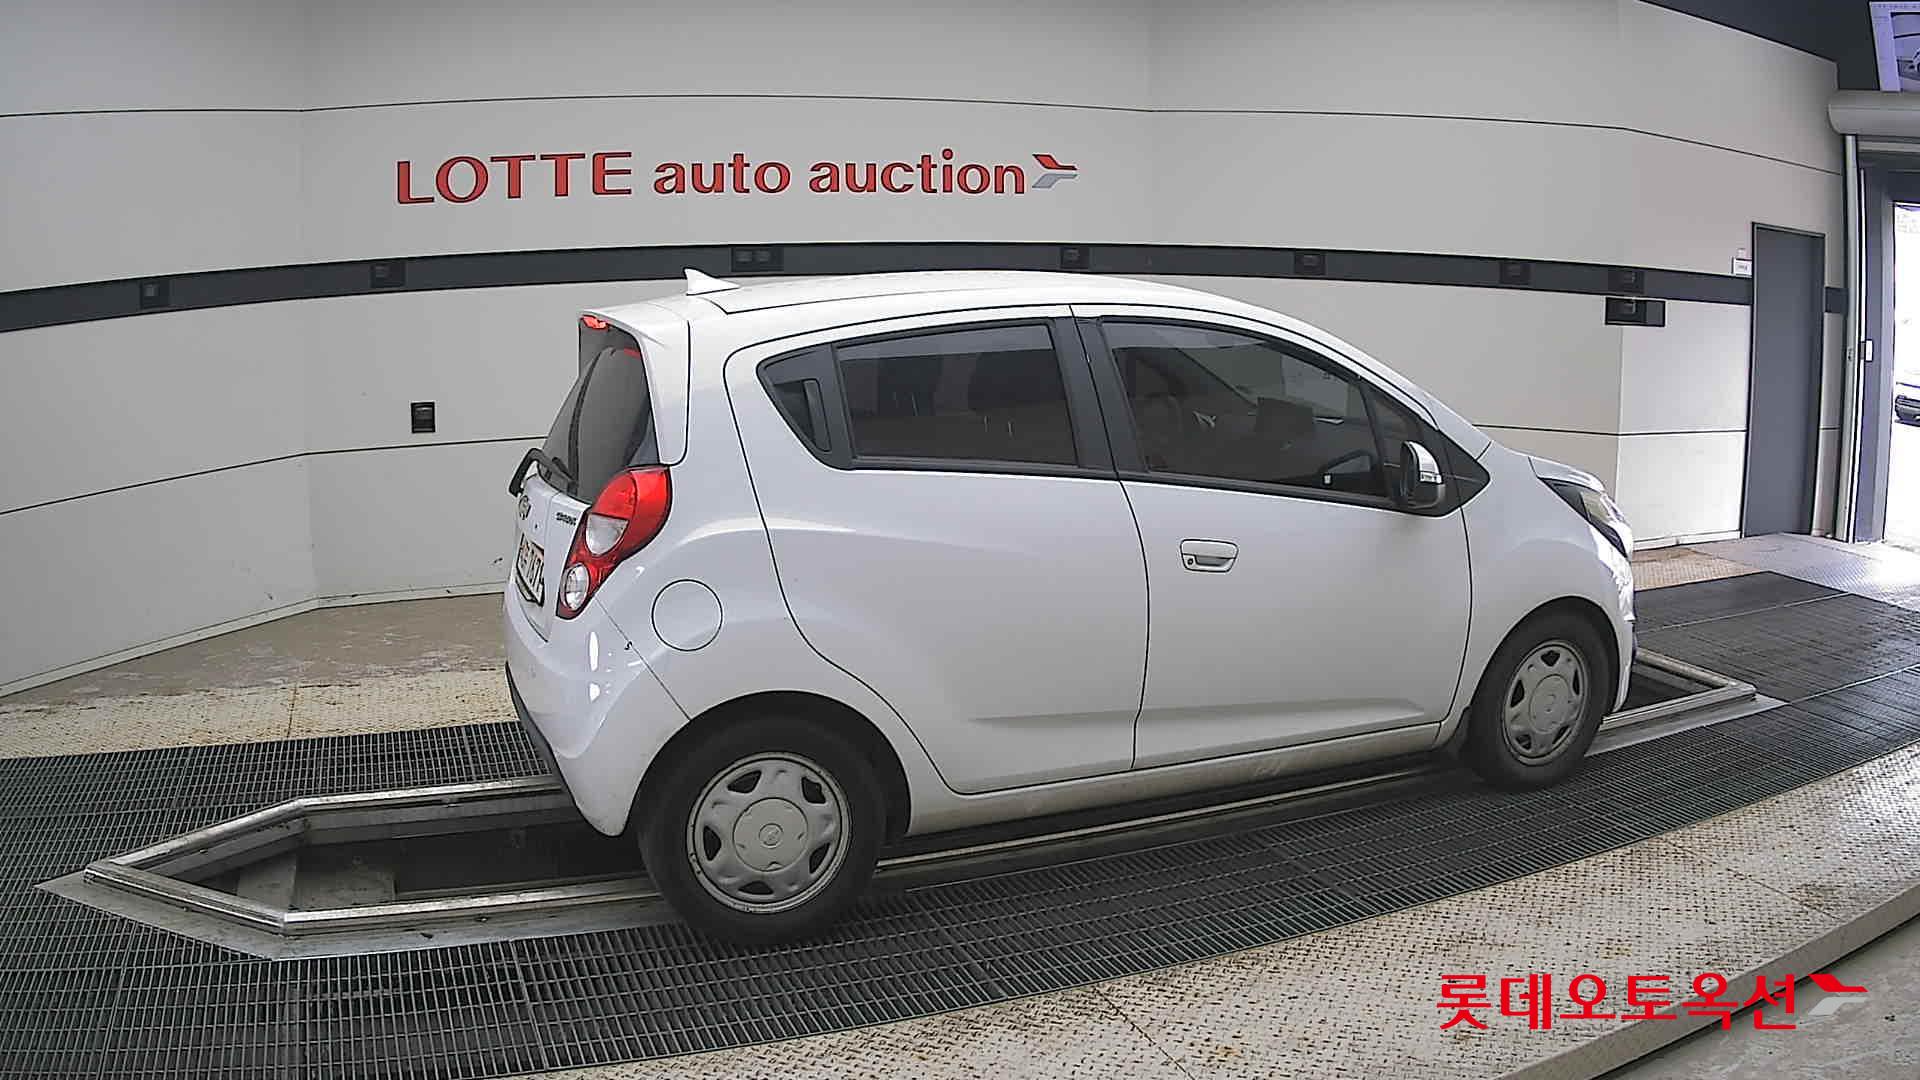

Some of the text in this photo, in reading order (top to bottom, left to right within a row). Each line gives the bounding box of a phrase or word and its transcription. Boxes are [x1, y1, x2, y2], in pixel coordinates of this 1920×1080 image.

[397, 148, 1025, 204] LOTTE auto auction
